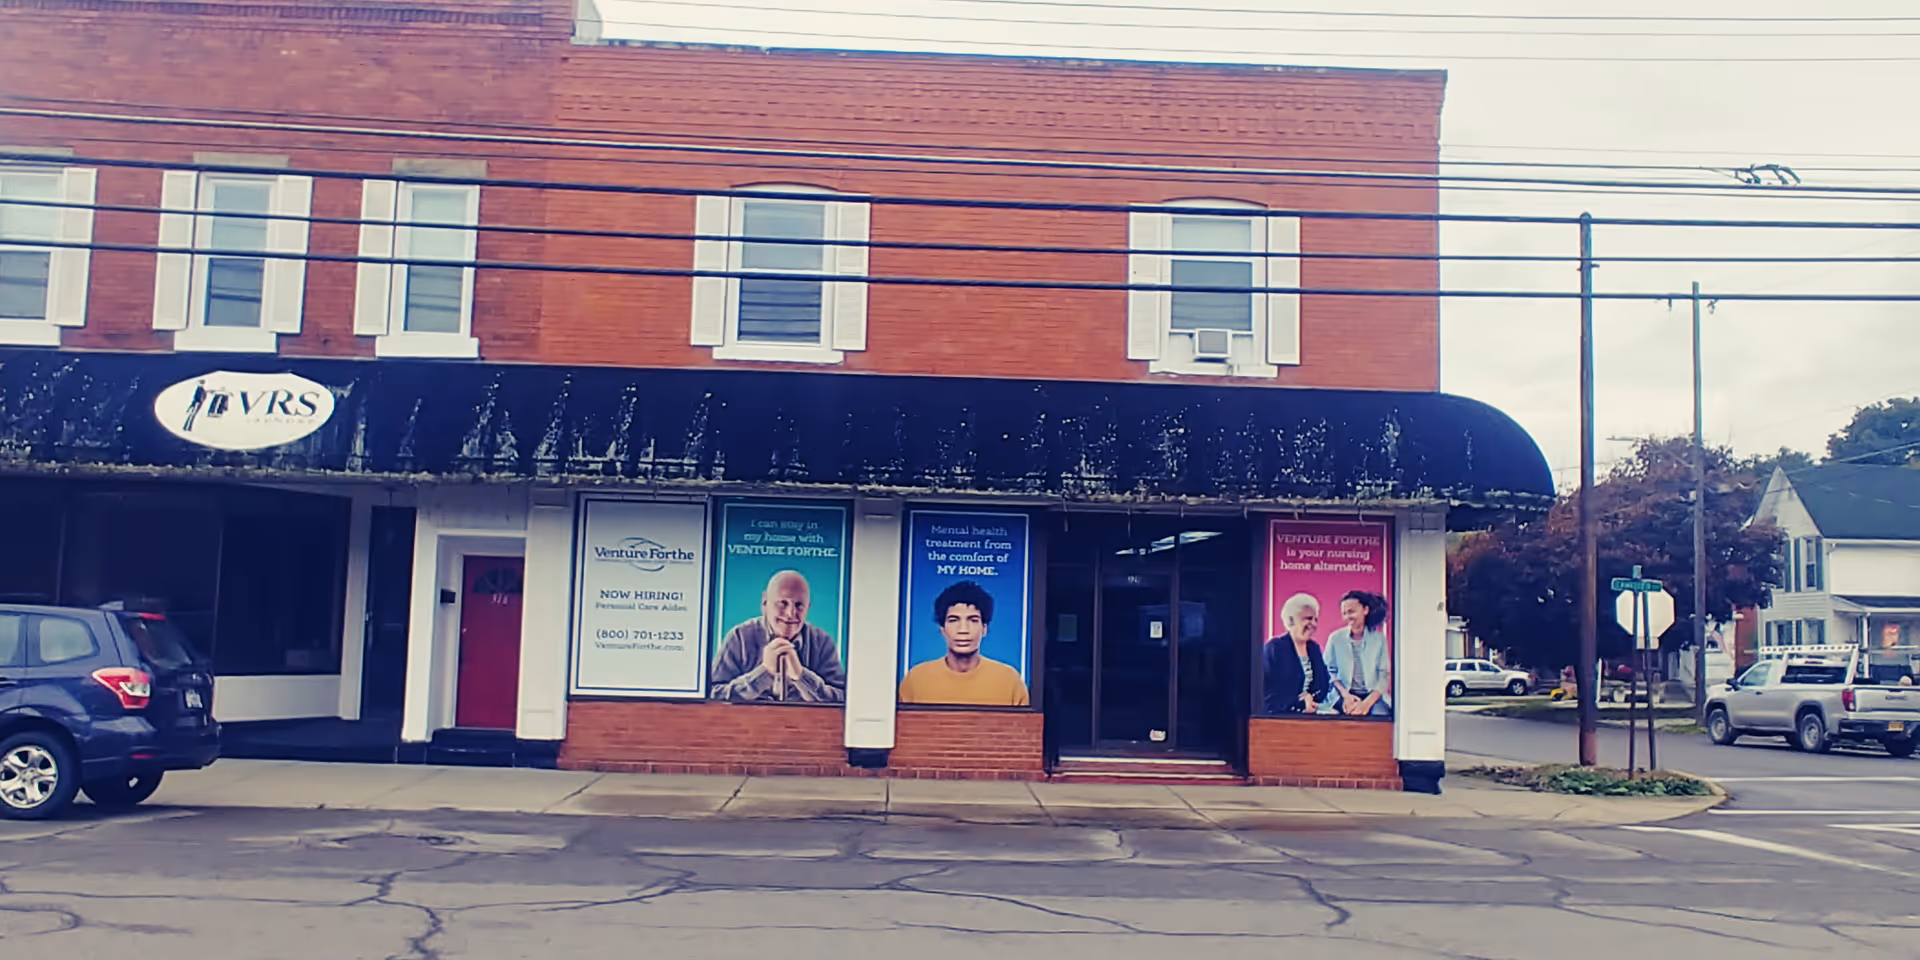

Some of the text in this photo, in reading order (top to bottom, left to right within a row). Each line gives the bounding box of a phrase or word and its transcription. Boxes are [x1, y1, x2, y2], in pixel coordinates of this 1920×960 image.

[240, 389, 320, 417] VRS
[758, 520, 778, 529] can
[780, 521, 804, 531] stay
[807, 522, 819, 530] in
[931, 525, 1008, 537] Mental health
[743, 531, 824, 544] my home with
[1277, 534, 1331, 544] VENTURE
[727, 544, 785, 555] VENTURE
[925, 538, 1012, 550] treatment from
[594, 546, 695, 560] Venture Forthe
[928, 551, 1009, 563] the comfort of
[1286, 547, 1370, 560] is your nursing
[937, 565, 999, 576] MY HOME.
[1280, 559, 1376, 572] home alternative.
[600, 589, 684, 602] NOW HIRING!
[596, 601, 687, 612] Personal Care Aides
[597, 629, 685, 641] (800) 701-1233
[595, 642, 684, 652] VentureForthe.com
